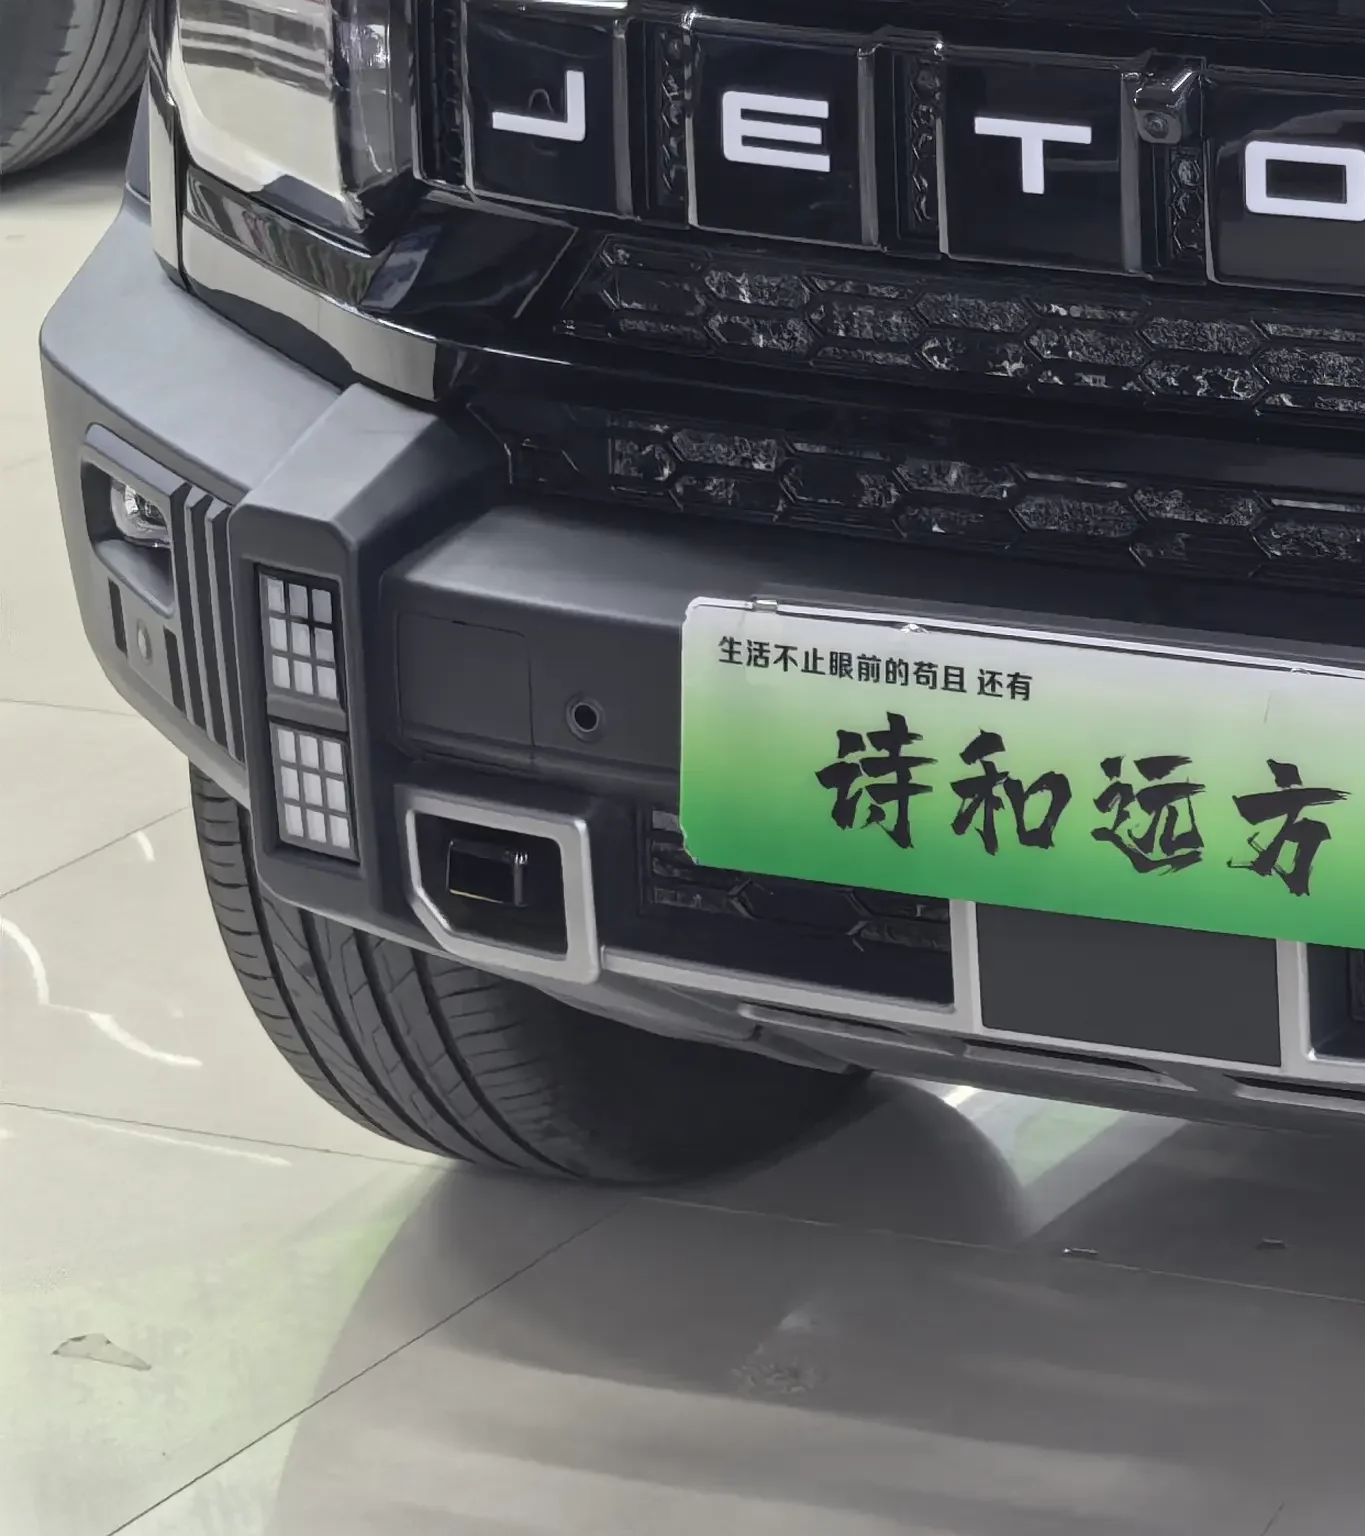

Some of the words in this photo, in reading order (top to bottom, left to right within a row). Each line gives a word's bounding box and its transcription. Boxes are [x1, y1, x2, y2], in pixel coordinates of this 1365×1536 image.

[717, 635, 967, 693] 生活不止眼前的苟且
[976, 667, 1034, 702] 还有
[814, 710, 1352, 897] 诗和远方
